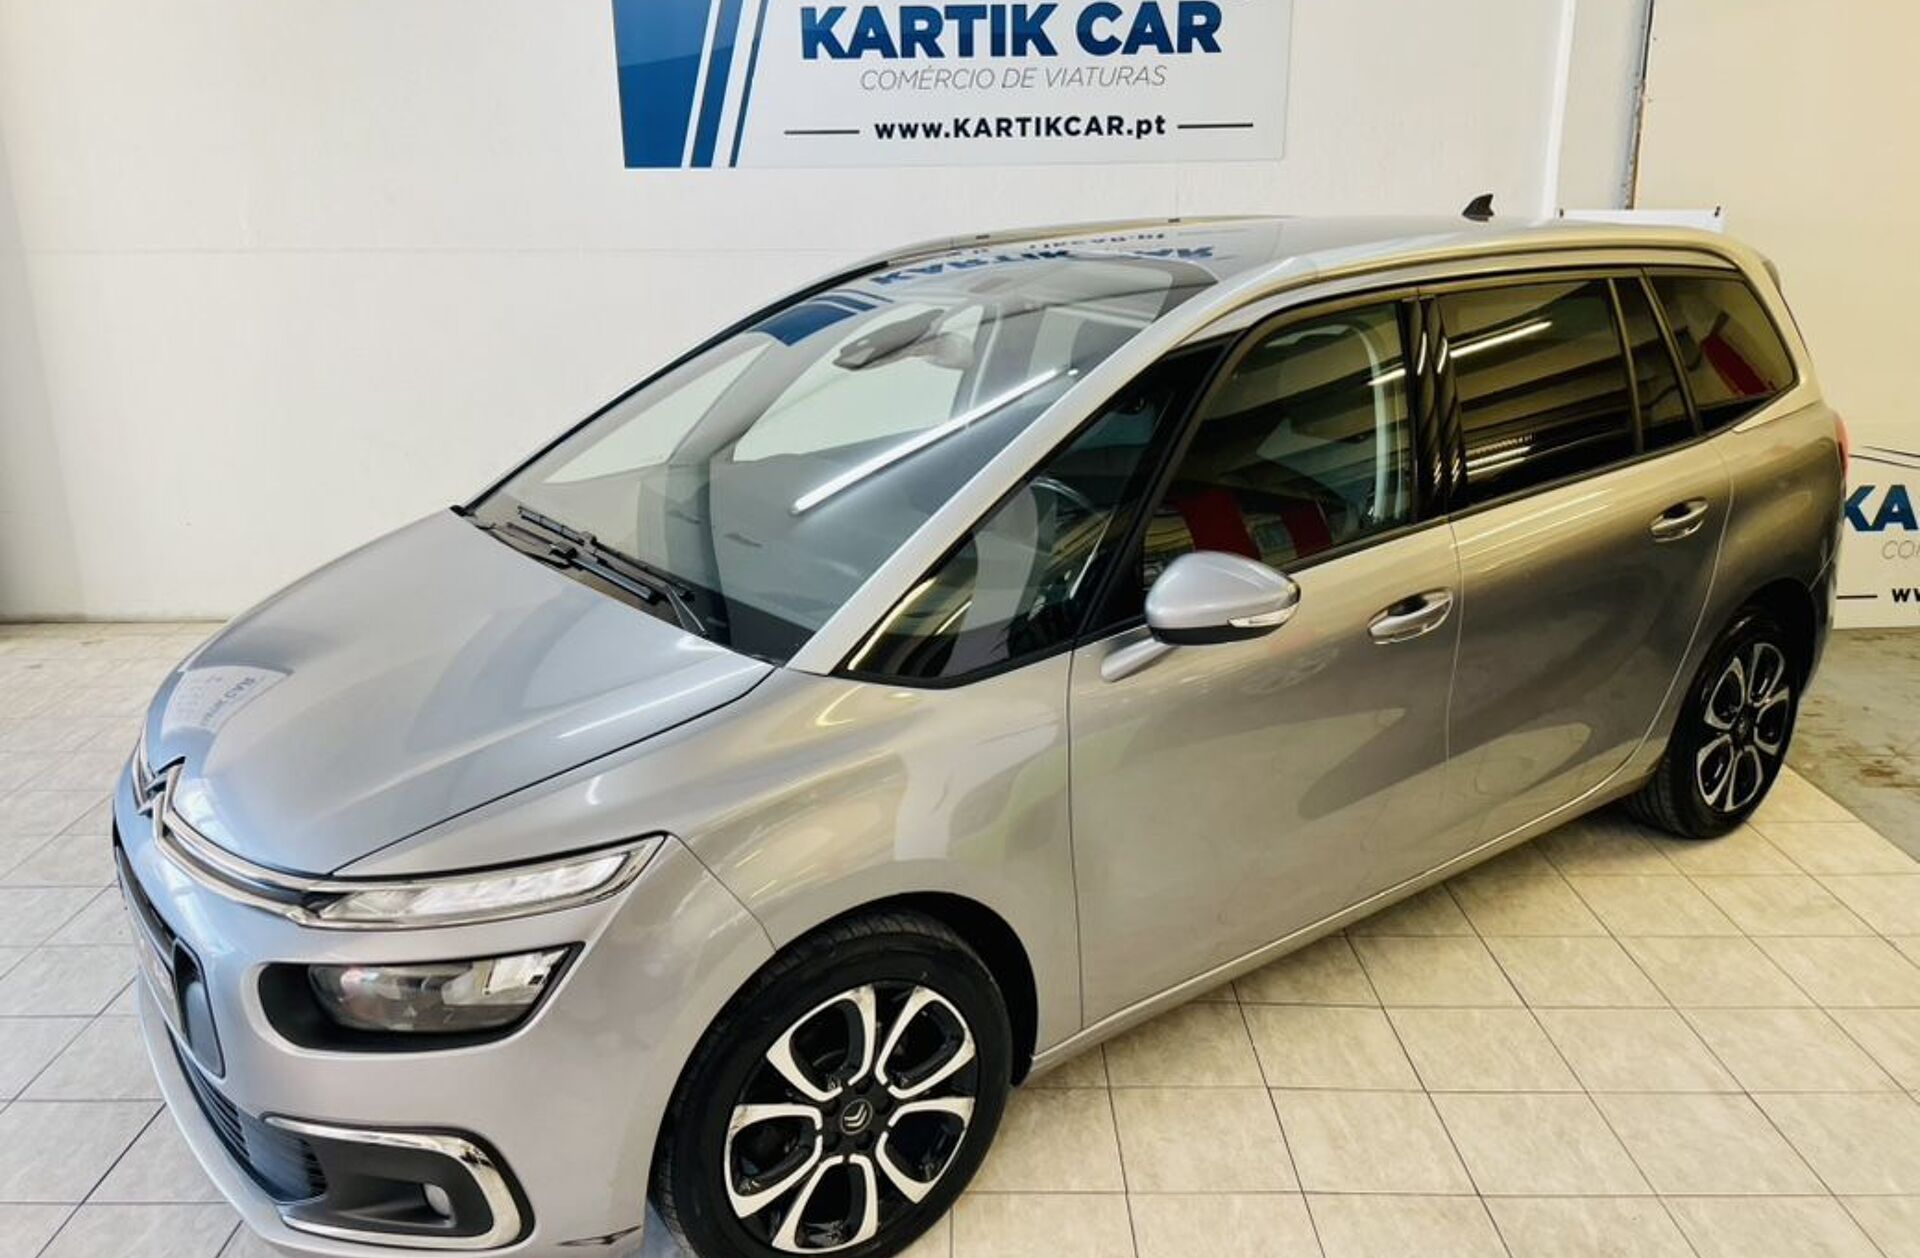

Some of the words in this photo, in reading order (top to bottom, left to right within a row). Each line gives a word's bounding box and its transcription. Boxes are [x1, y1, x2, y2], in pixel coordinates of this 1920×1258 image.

[800, 4, 1058, 59] KARTIK
[1076, 1, 1222, 56] CAR
[860, 65, 995, 90] COMÉRCIO
[1001, 66, 1037, 89] DE
[1045, 64, 1168, 88] VIATURAS
[874, 115, 1167, 139] www.KARTIKCAR.pt
